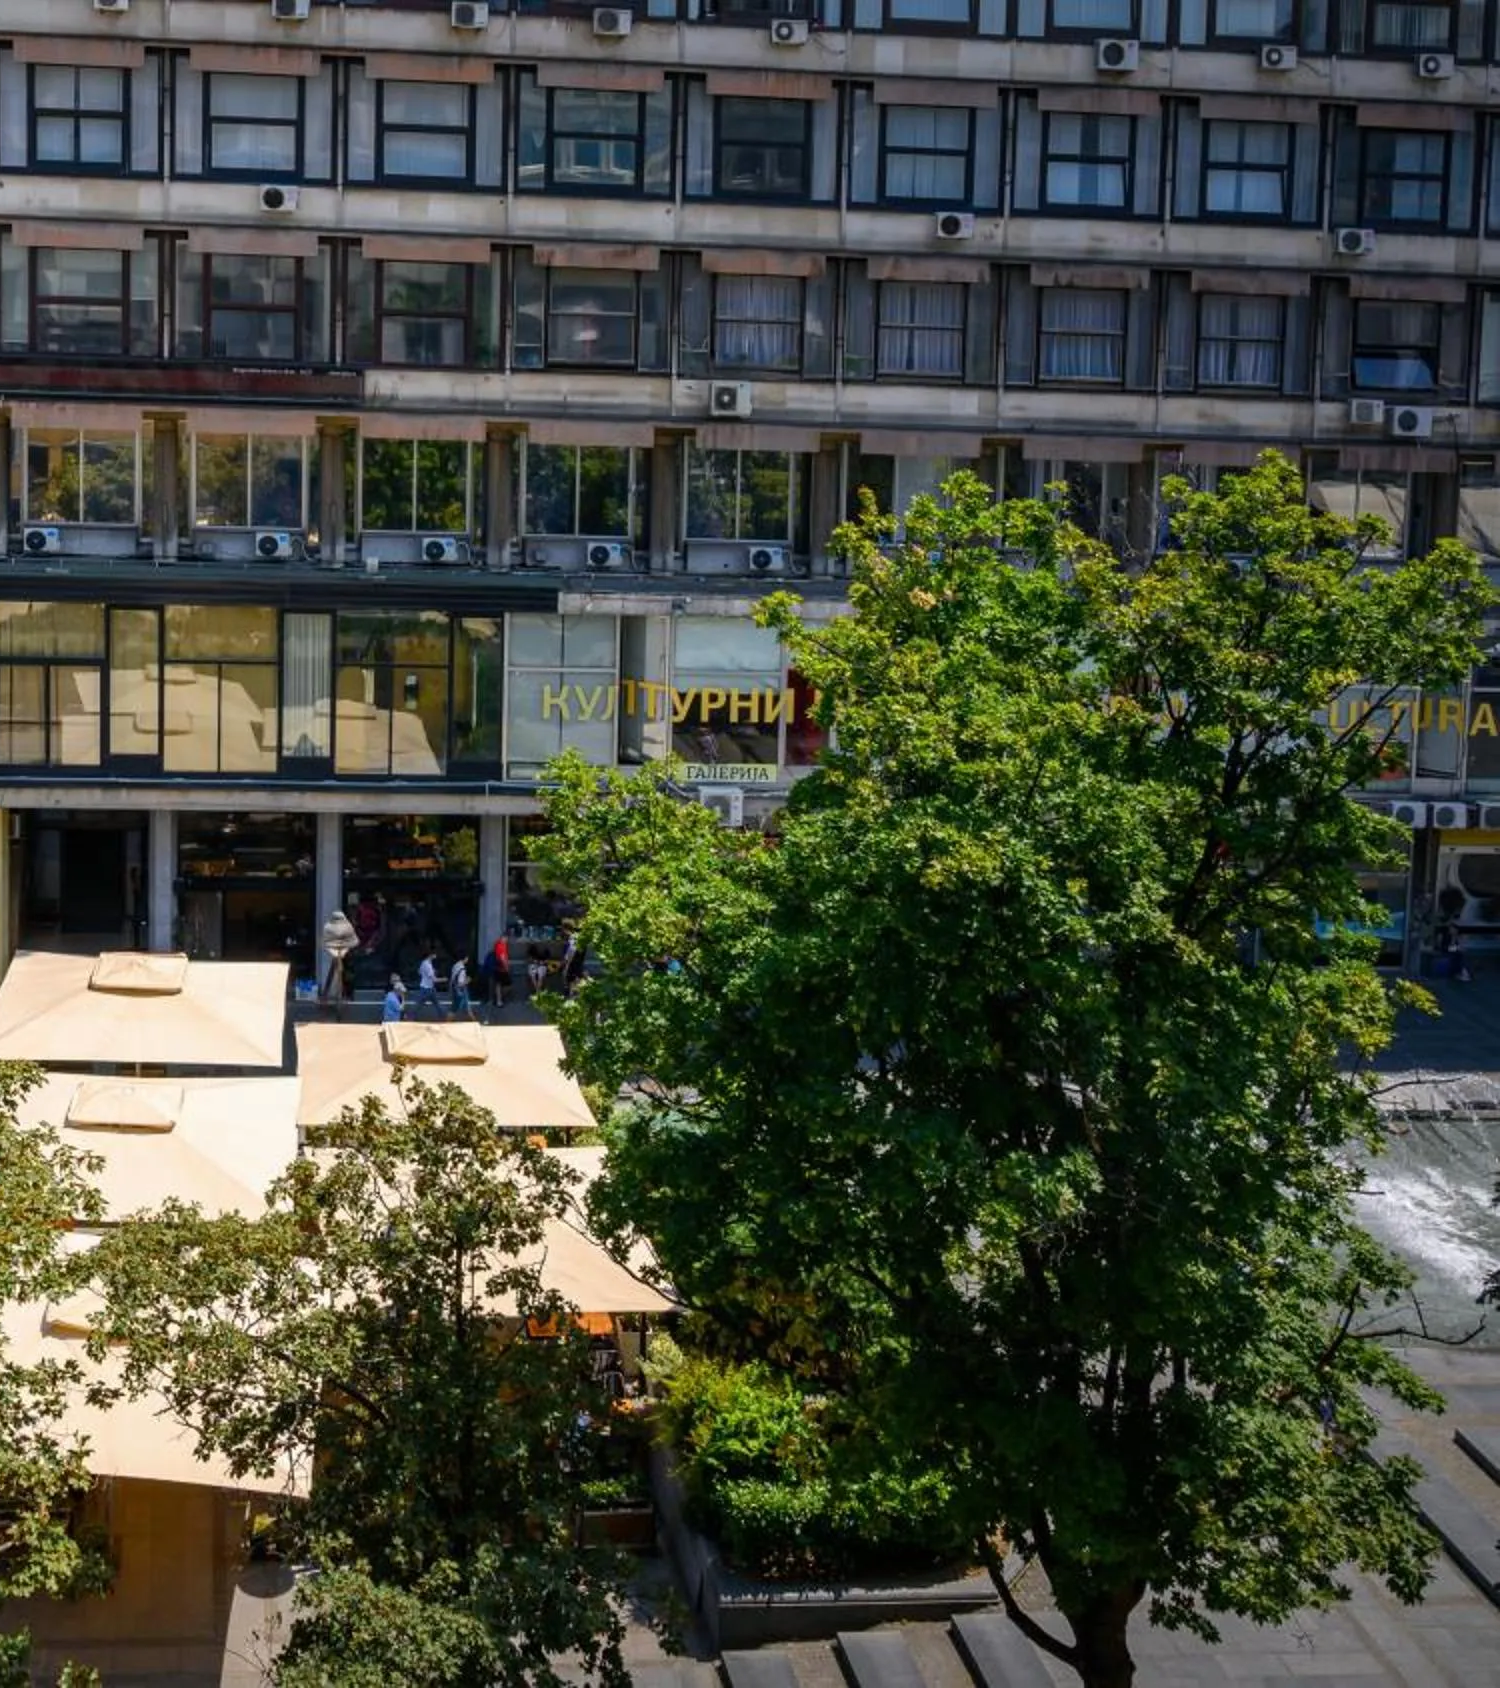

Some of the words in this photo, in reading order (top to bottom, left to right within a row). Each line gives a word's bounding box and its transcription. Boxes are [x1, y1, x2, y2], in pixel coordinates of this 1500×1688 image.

[542, 679, 795, 724] КУЛТУРНИ
[1329, 698, 1499, 737] ULTURA
[686, 765, 769, 781] ГАЛЕРИЈА
